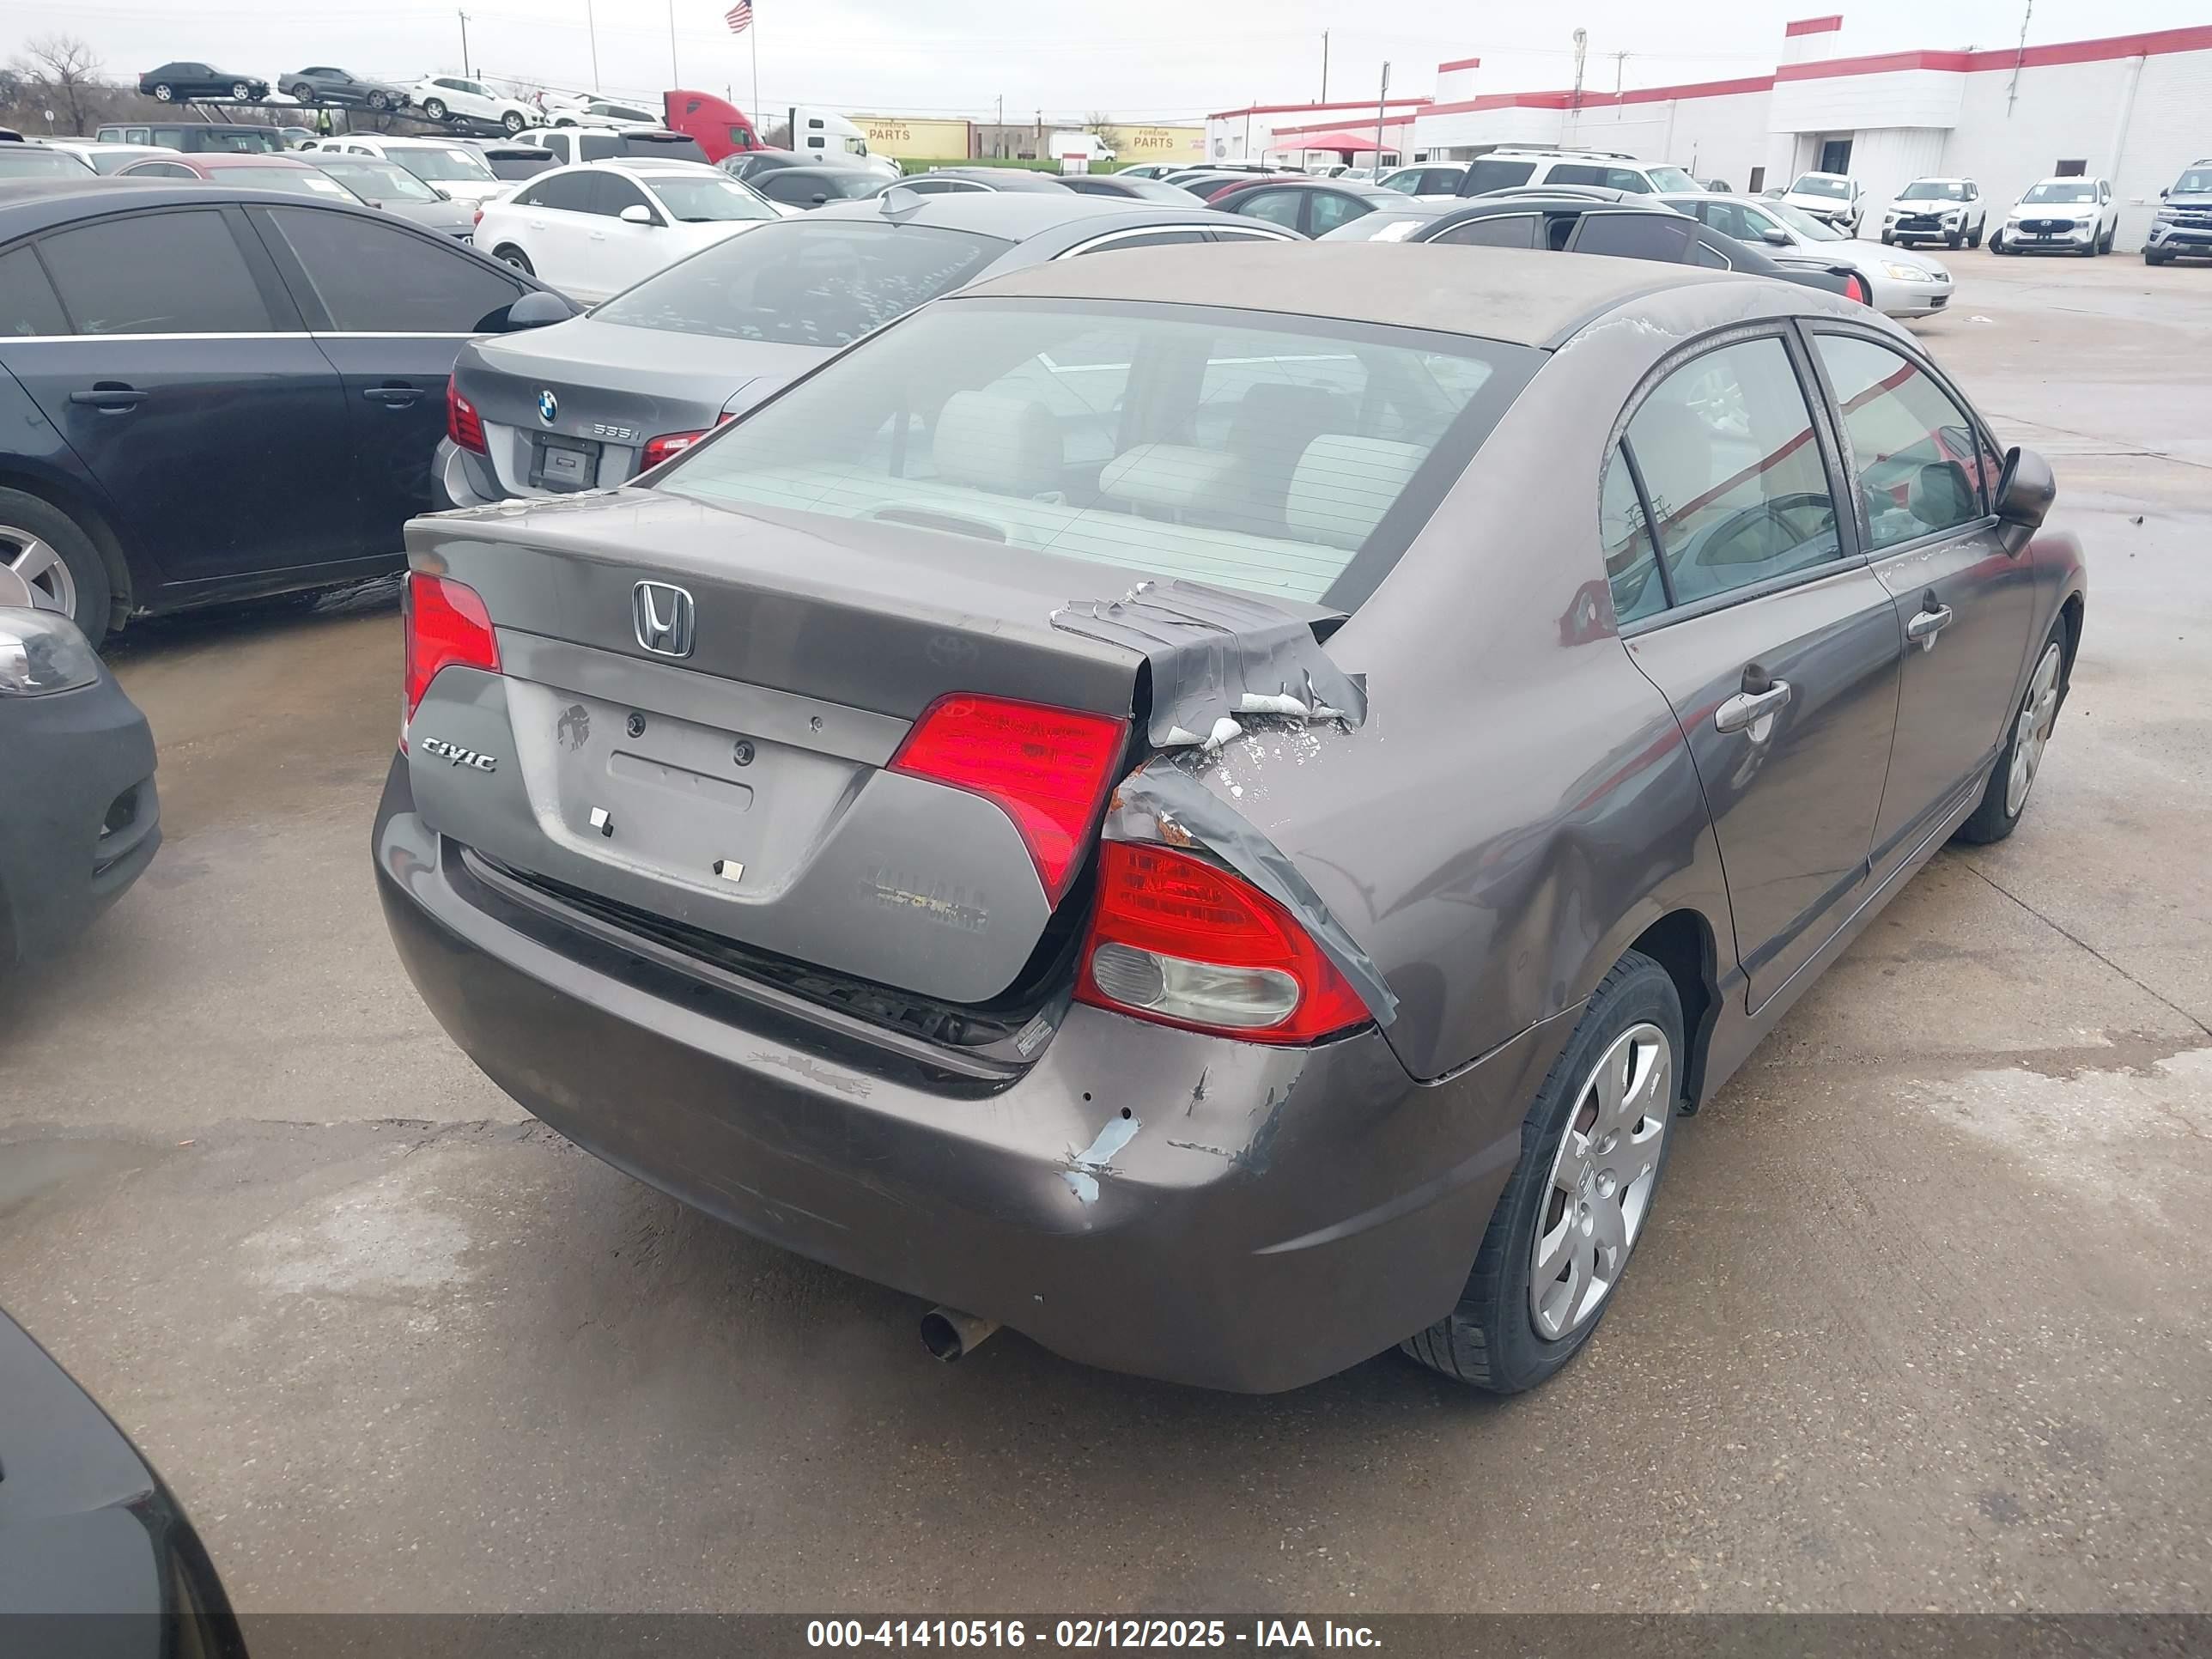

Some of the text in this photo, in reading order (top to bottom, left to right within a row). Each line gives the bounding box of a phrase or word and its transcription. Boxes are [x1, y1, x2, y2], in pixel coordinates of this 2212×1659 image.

[869, 129, 910, 140] PARTS
[1134, 137, 1173, 149] PARTS
[422, 737, 497, 773] CIVIC
